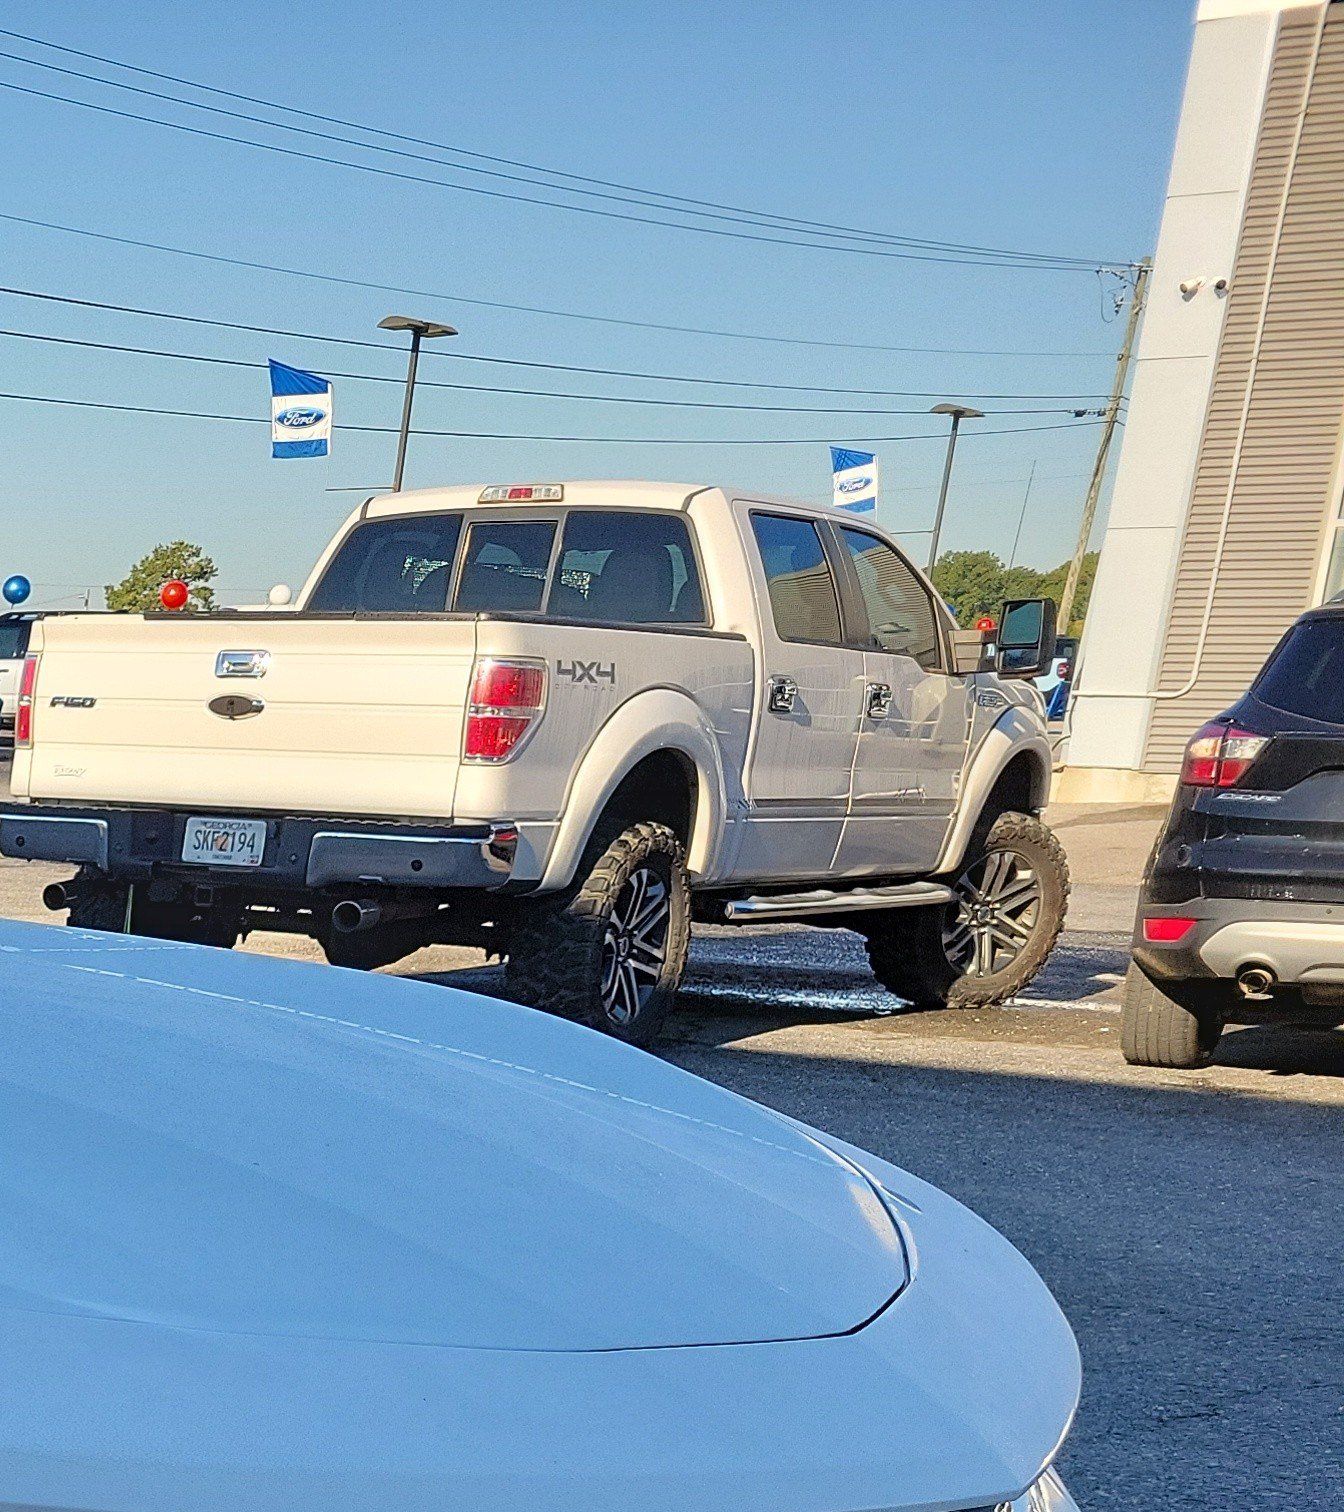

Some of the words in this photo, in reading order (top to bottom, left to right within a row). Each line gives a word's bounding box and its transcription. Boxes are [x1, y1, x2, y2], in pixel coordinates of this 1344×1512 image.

[283, 410, 318, 426] Ford
[557, 659, 616, 684] 4X4
[204, 821, 248, 831] GEORGIA
[193, 829, 257, 854] SKF2194
